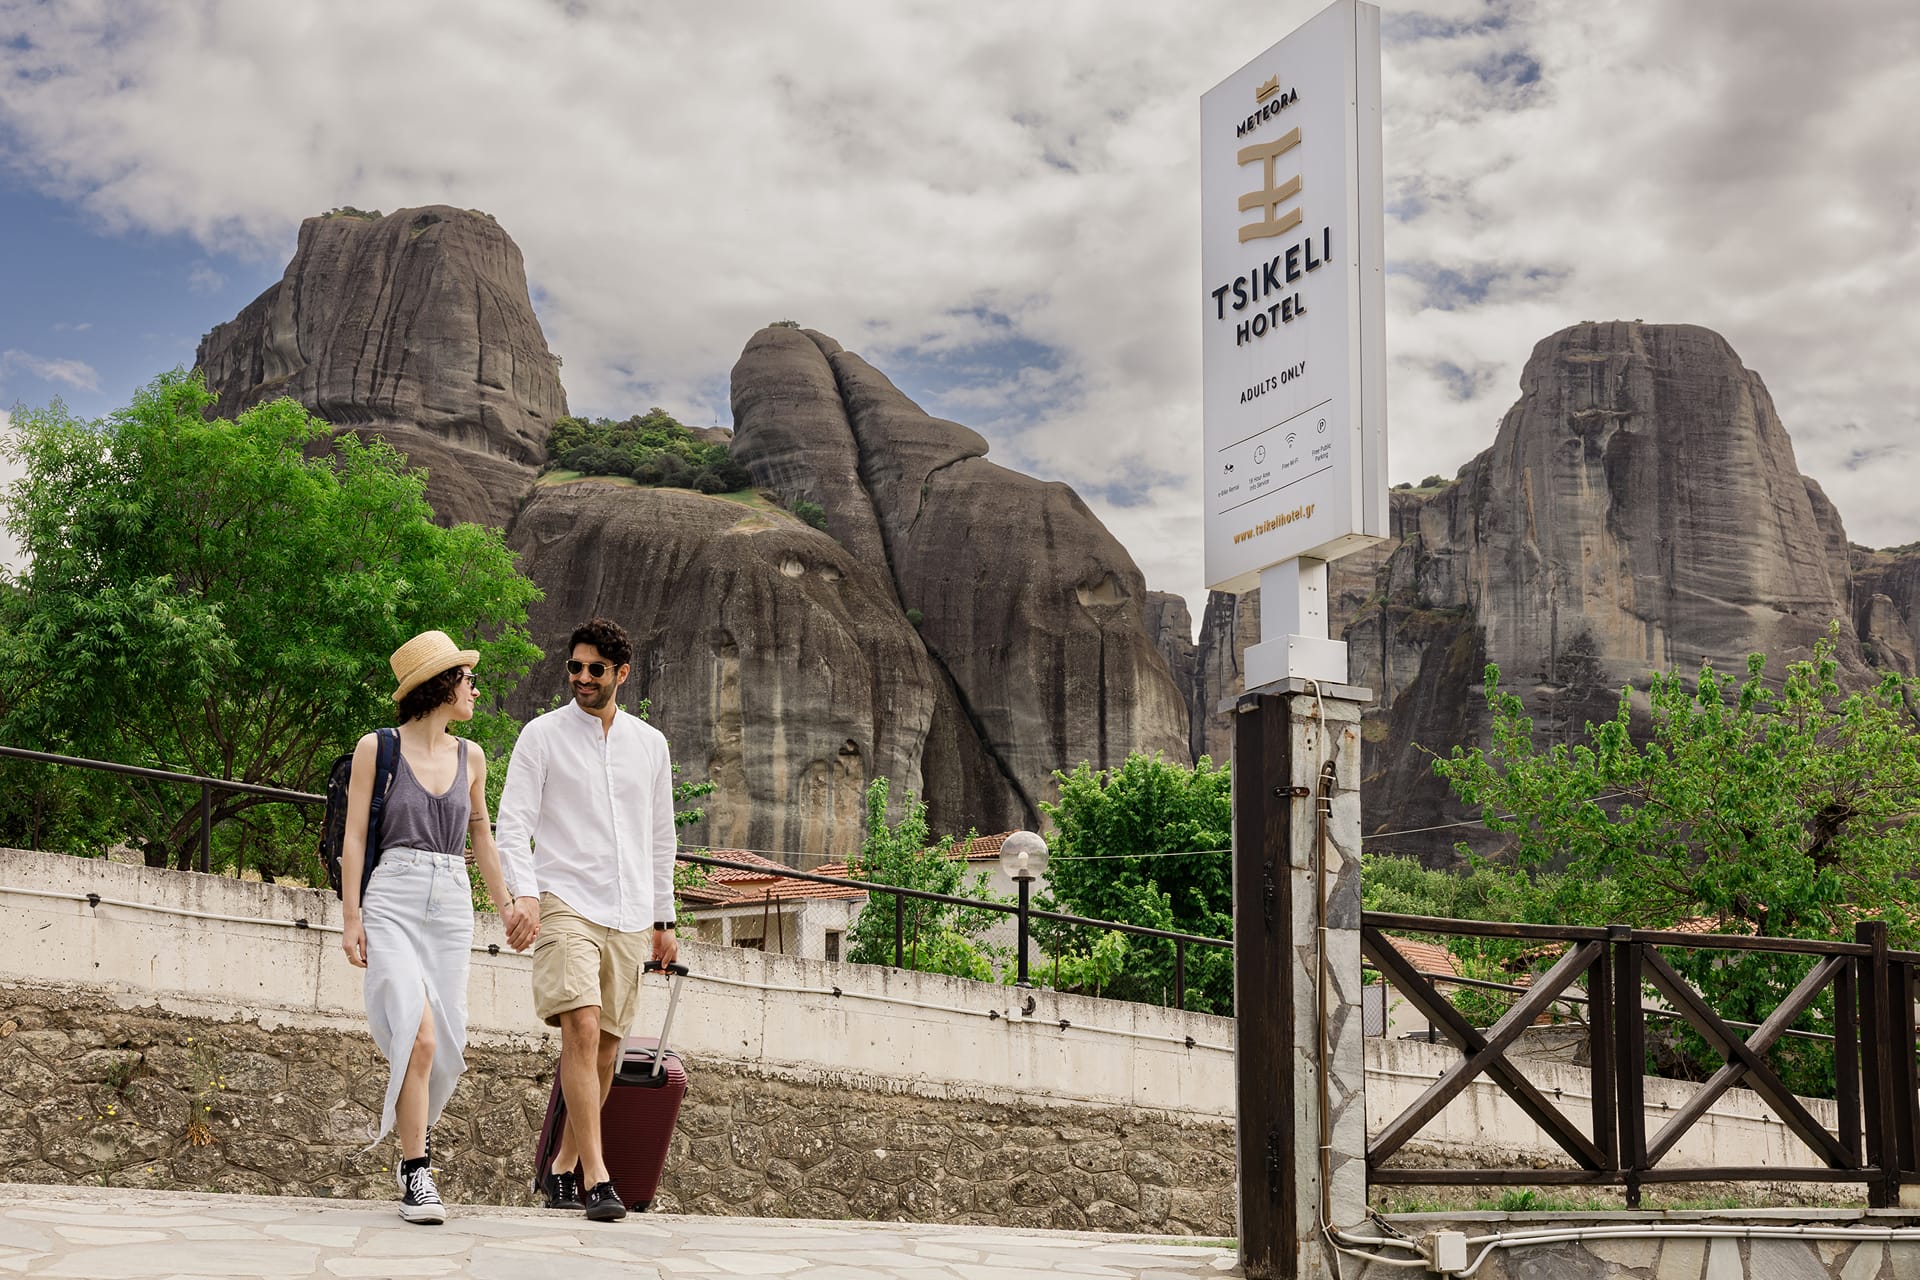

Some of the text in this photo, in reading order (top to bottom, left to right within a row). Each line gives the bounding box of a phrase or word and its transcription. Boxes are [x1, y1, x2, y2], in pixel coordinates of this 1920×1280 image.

[1236, 87, 1298, 138] METEORA
[1211, 226, 1331, 321] TSIKELI
[1236, 292, 1307, 347] HOTEL
[1240, 360, 1306, 405] ADULTS ONLY
[1233, 503, 1315, 545] www.tsikelihotel.gr
